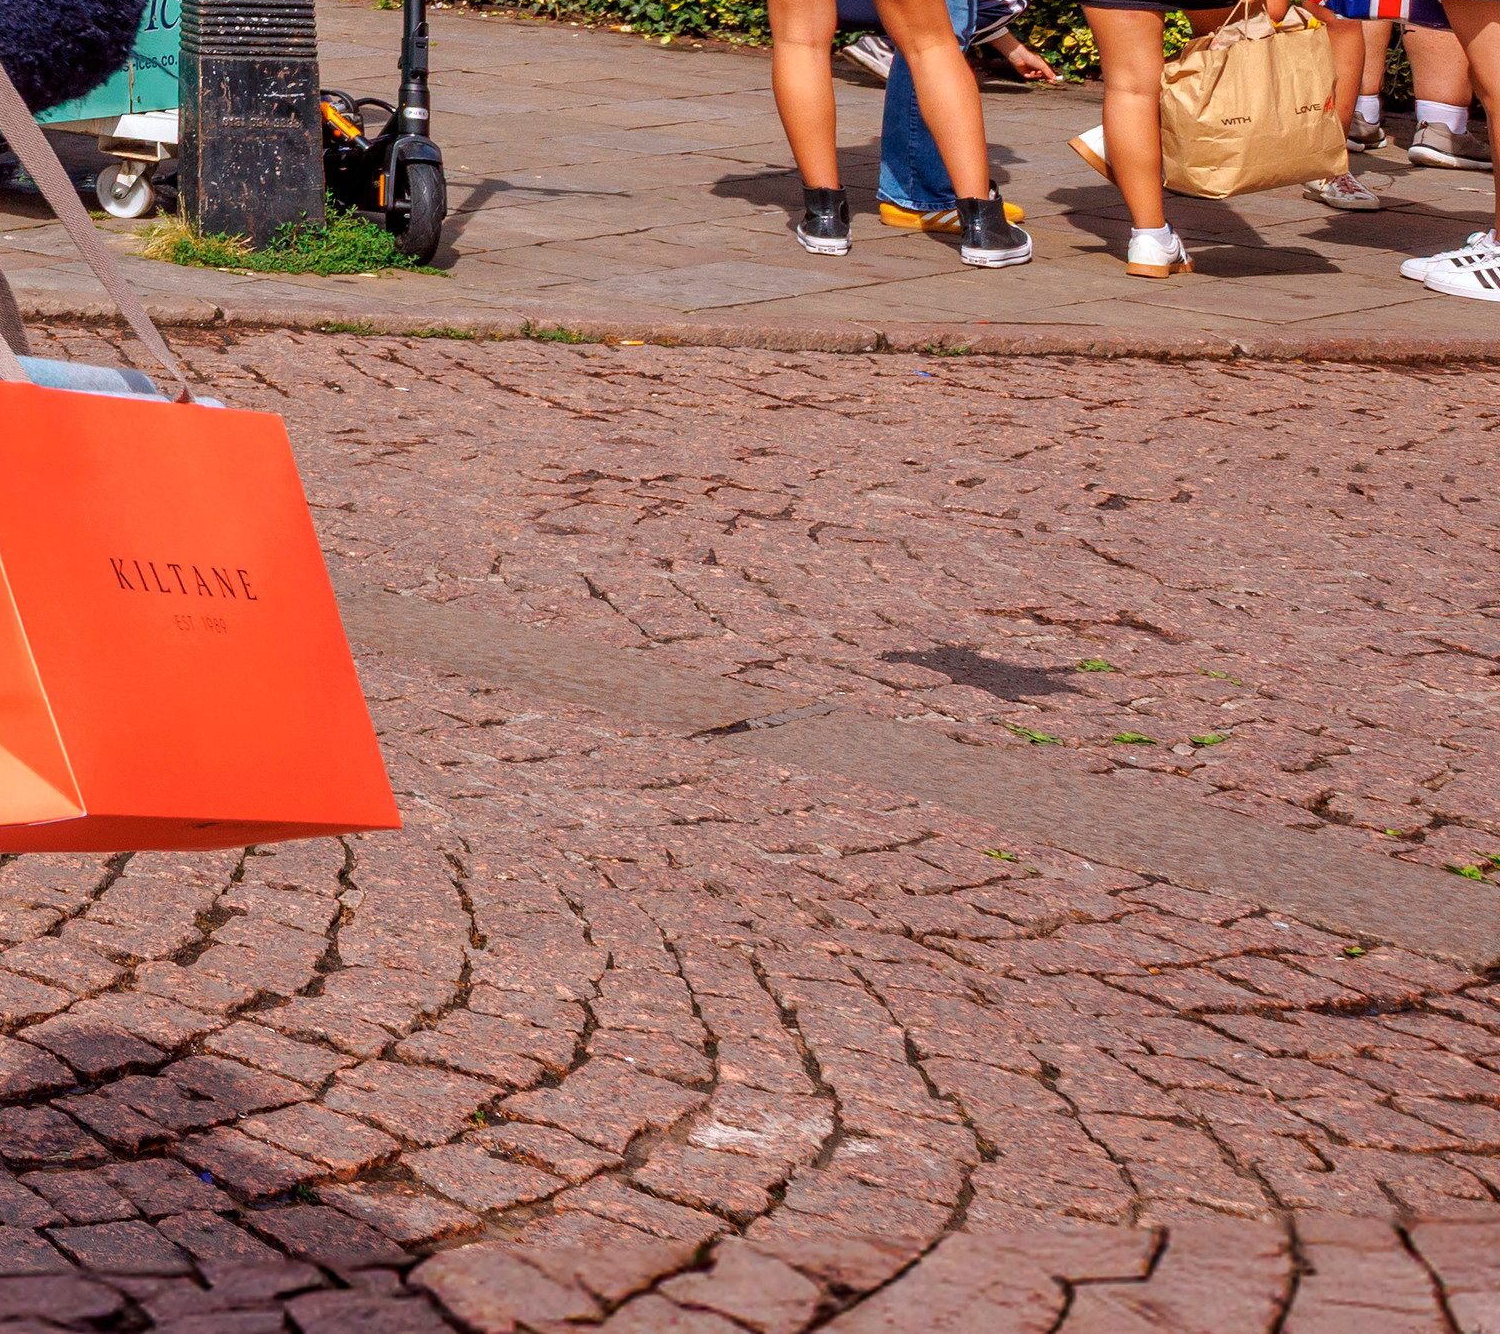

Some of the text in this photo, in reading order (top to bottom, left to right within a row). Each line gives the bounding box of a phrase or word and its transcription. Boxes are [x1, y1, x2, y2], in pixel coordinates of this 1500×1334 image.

[1221, 116, 1252, 125] WITH
[1294, 103, 1321, 115] LOVE
[109, 557, 258, 601] KILTANE
